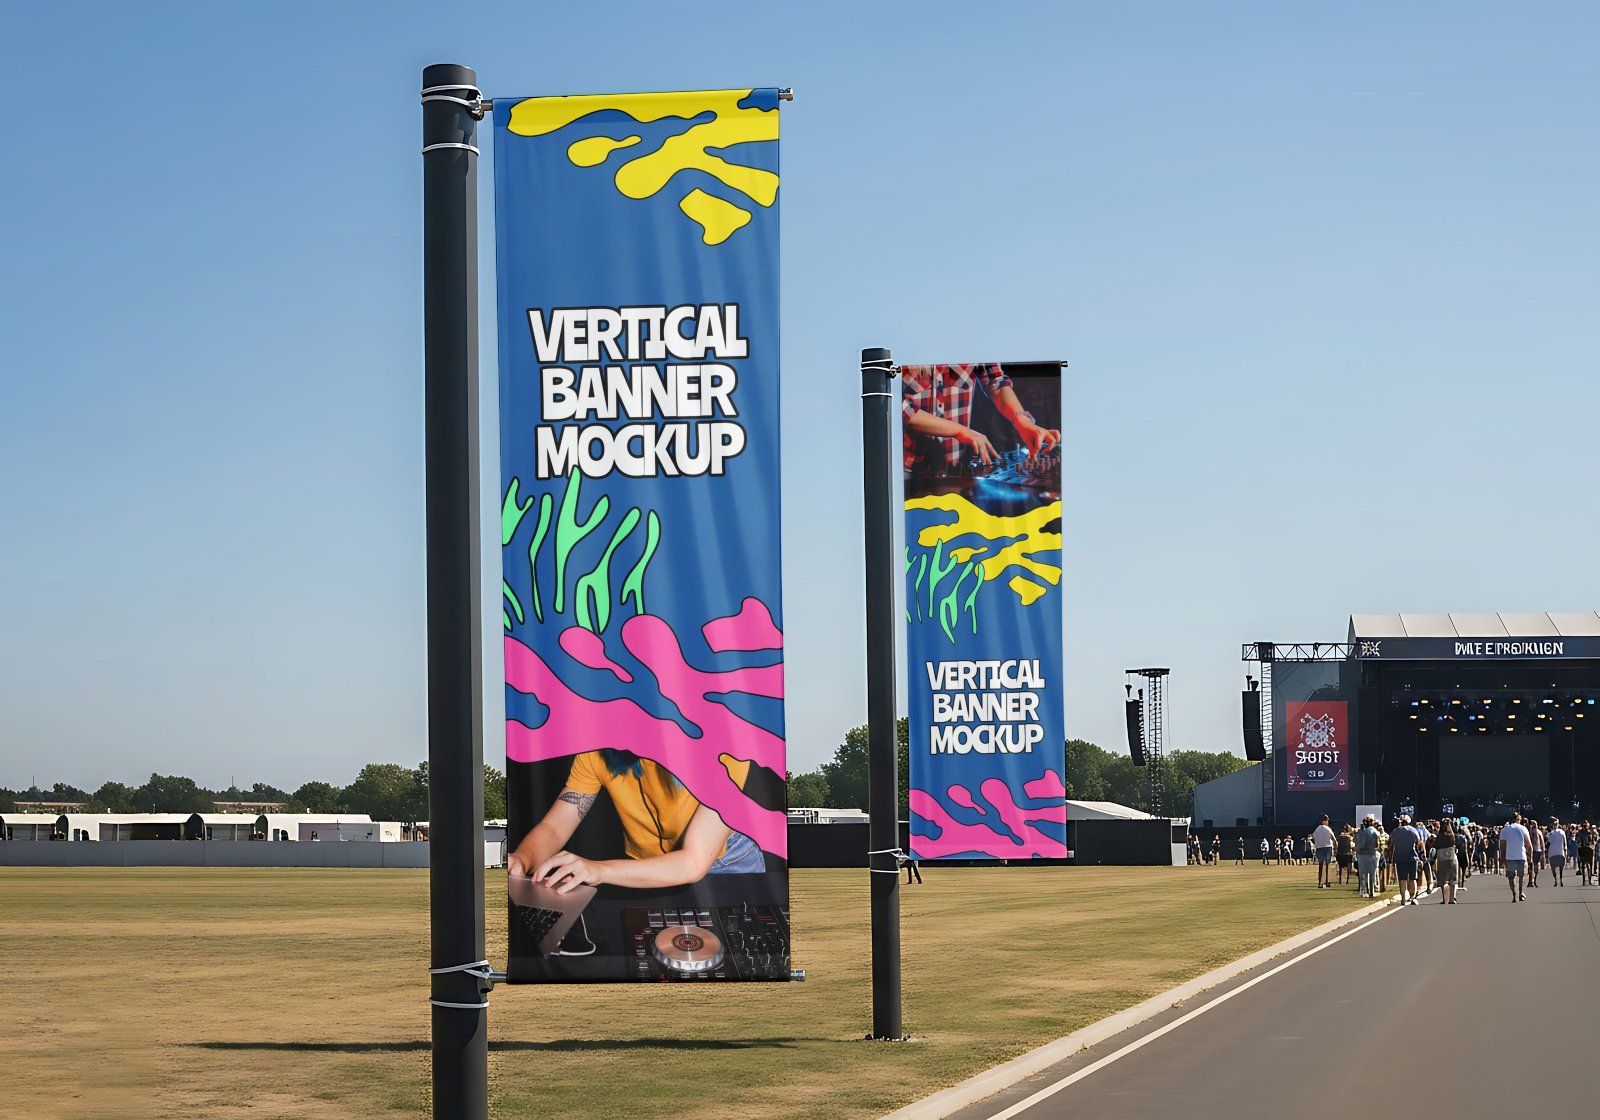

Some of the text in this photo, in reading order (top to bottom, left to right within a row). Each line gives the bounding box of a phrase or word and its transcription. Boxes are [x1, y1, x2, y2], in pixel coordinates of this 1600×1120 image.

[527, 303, 749, 363] VERTICAL
[540, 363, 739, 421] BANNER
[535, 421, 747, 479] MOCKUP
[925, 659, 1046, 690] VERTICAL
[933, 691, 1040, 722] BANNER
[930, 723, 1044, 754] MOCKUP
